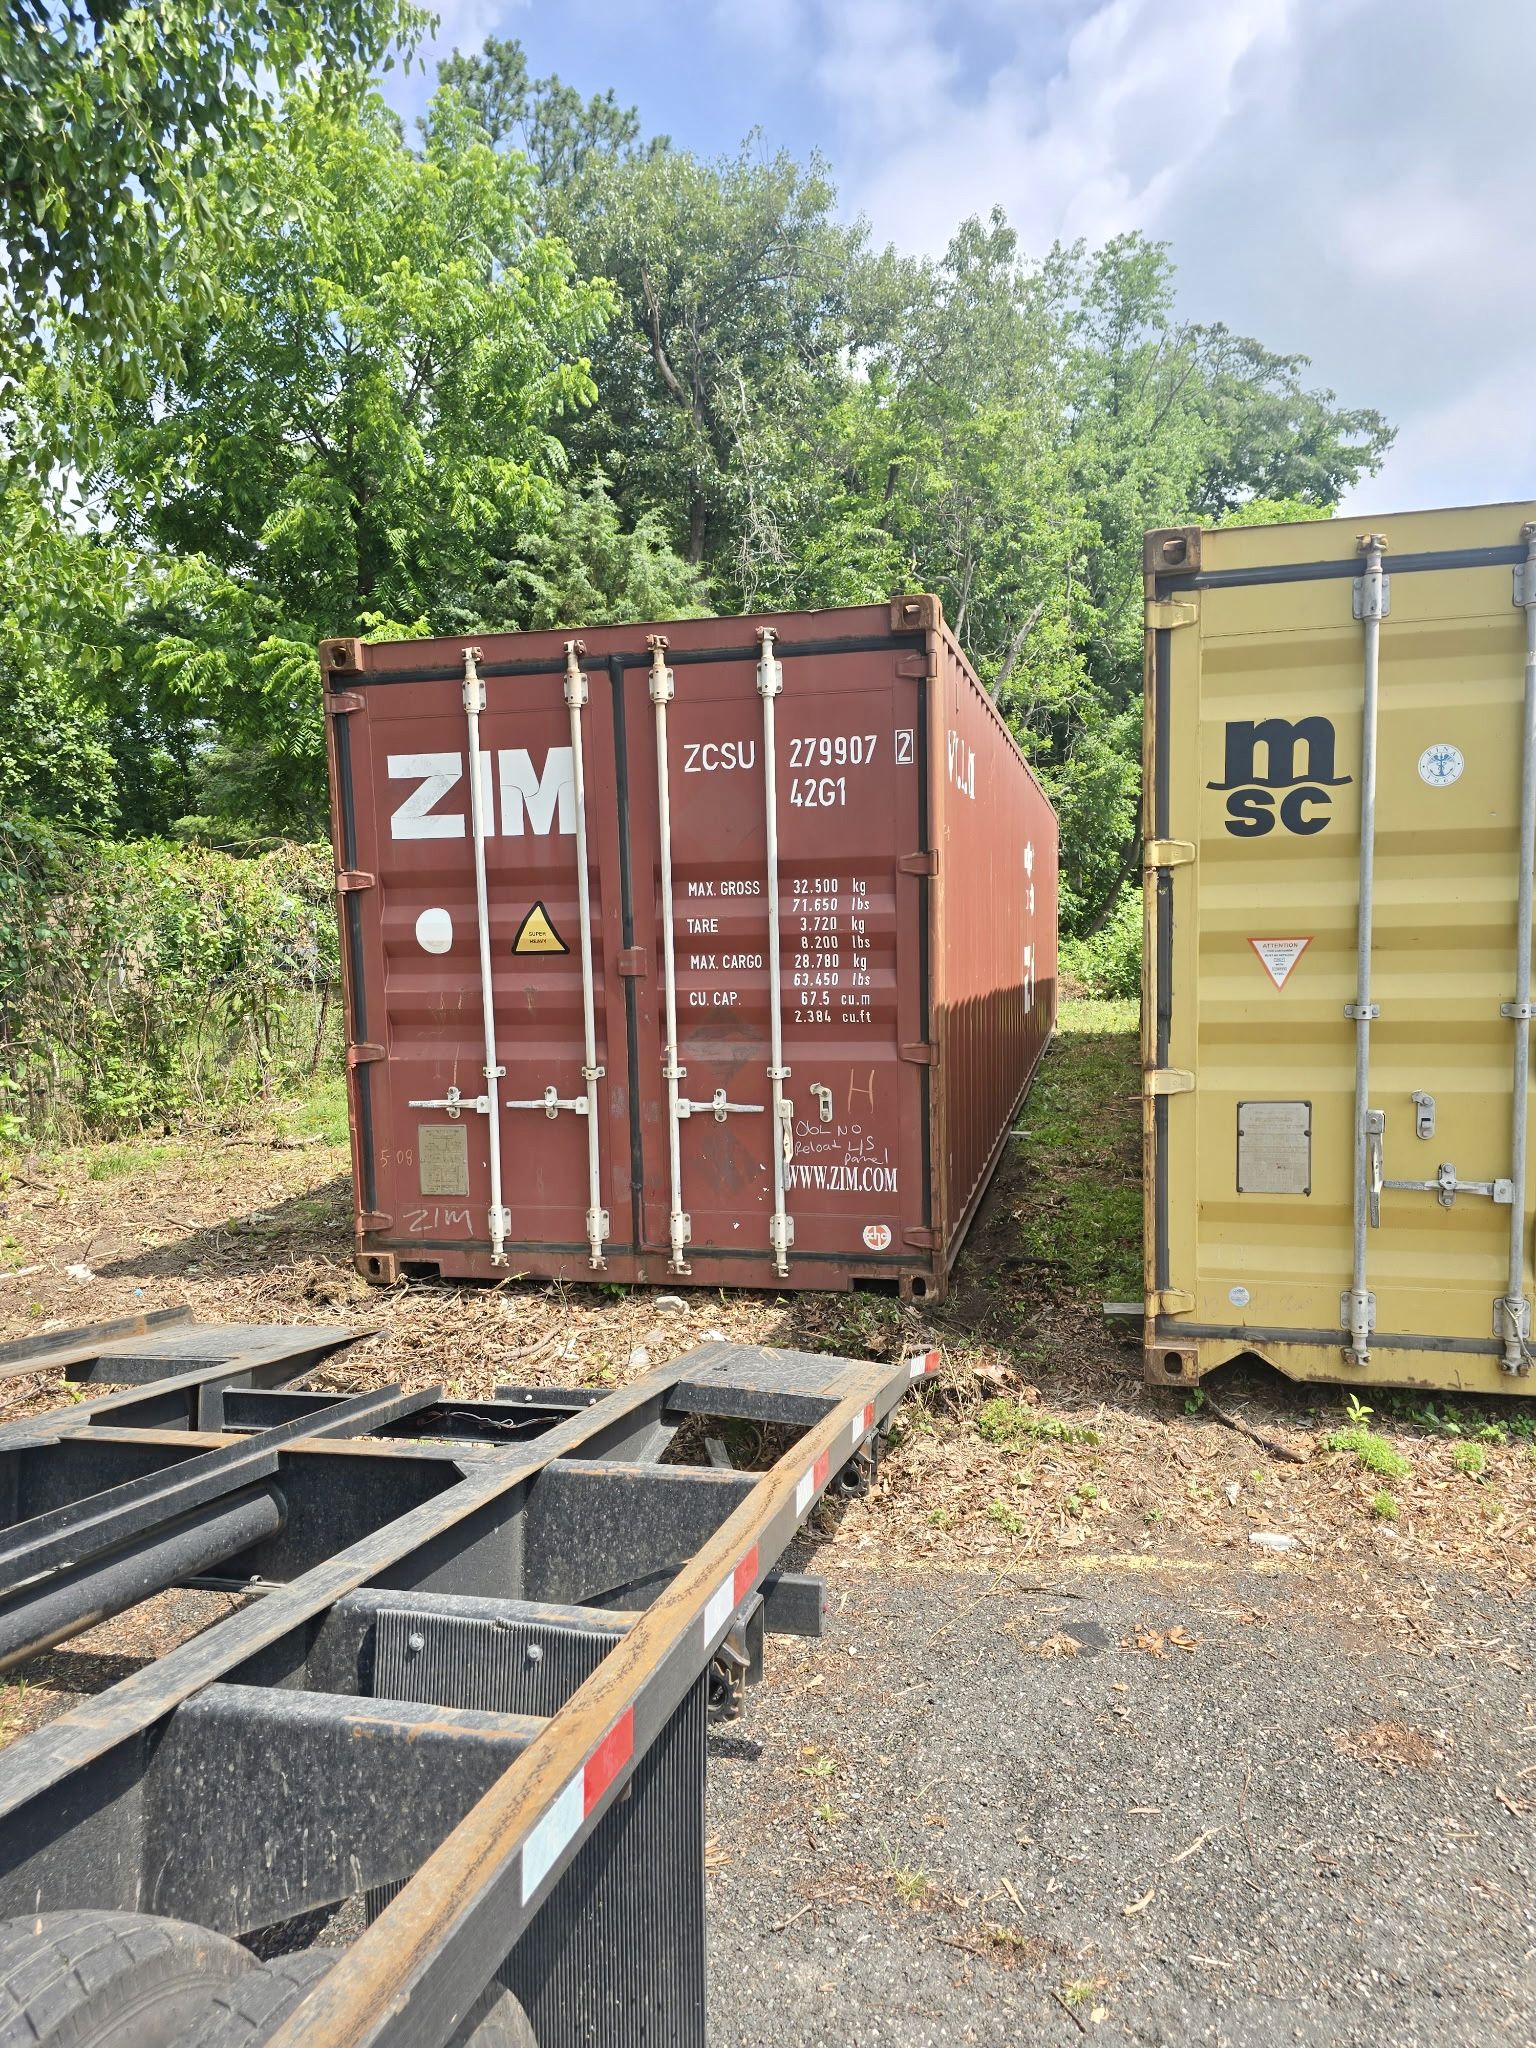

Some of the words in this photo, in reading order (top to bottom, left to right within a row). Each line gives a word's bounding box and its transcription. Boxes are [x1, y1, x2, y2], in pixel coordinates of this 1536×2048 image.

[683, 740, 755, 773] ZCSU
[789, 734, 878, 768] 279907
[897, 732, 911, 762] 2
[387, 746, 578, 840] ZIM
[789, 776, 846, 807] 42G1
[688, 881, 717, 897] MAX.
[720, 880, 760, 896] GROSS
[793, 878, 838, 895] 32.500
[852, 877, 867, 896] kg
[792, 898, 838, 912] 71.650
[851, 897, 870, 911] lbs
[687, 918, 719, 934] TARE
[800, 916, 838, 932] 3.720
[851, 915, 865, 934] kg
[801, 935, 839, 949] 8.200
[852, 935, 871, 949] lbs
[690, 954, 719, 970] MAX.
[722, 954, 763, 969] CARGO
[794, 953, 839, 969] 28.780
[853, 953, 867, 971] kg
[793, 972, 839, 986] 63.450
[852, 972, 871, 986] lbs
[689, 991, 710, 1007] CU.
[713, 991, 742, 1006] CAP.
[801, 990, 830, 1006] 67.5
[841, 992, 870, 1006] cu.m
[794, 1010, 832, 1023] 2.384
[842, 1009, 872, 1023] cu.ft
[847, 1068, 876, 1114] H
[788, 1165, 898, 1193] WWW.ZIM.COM
